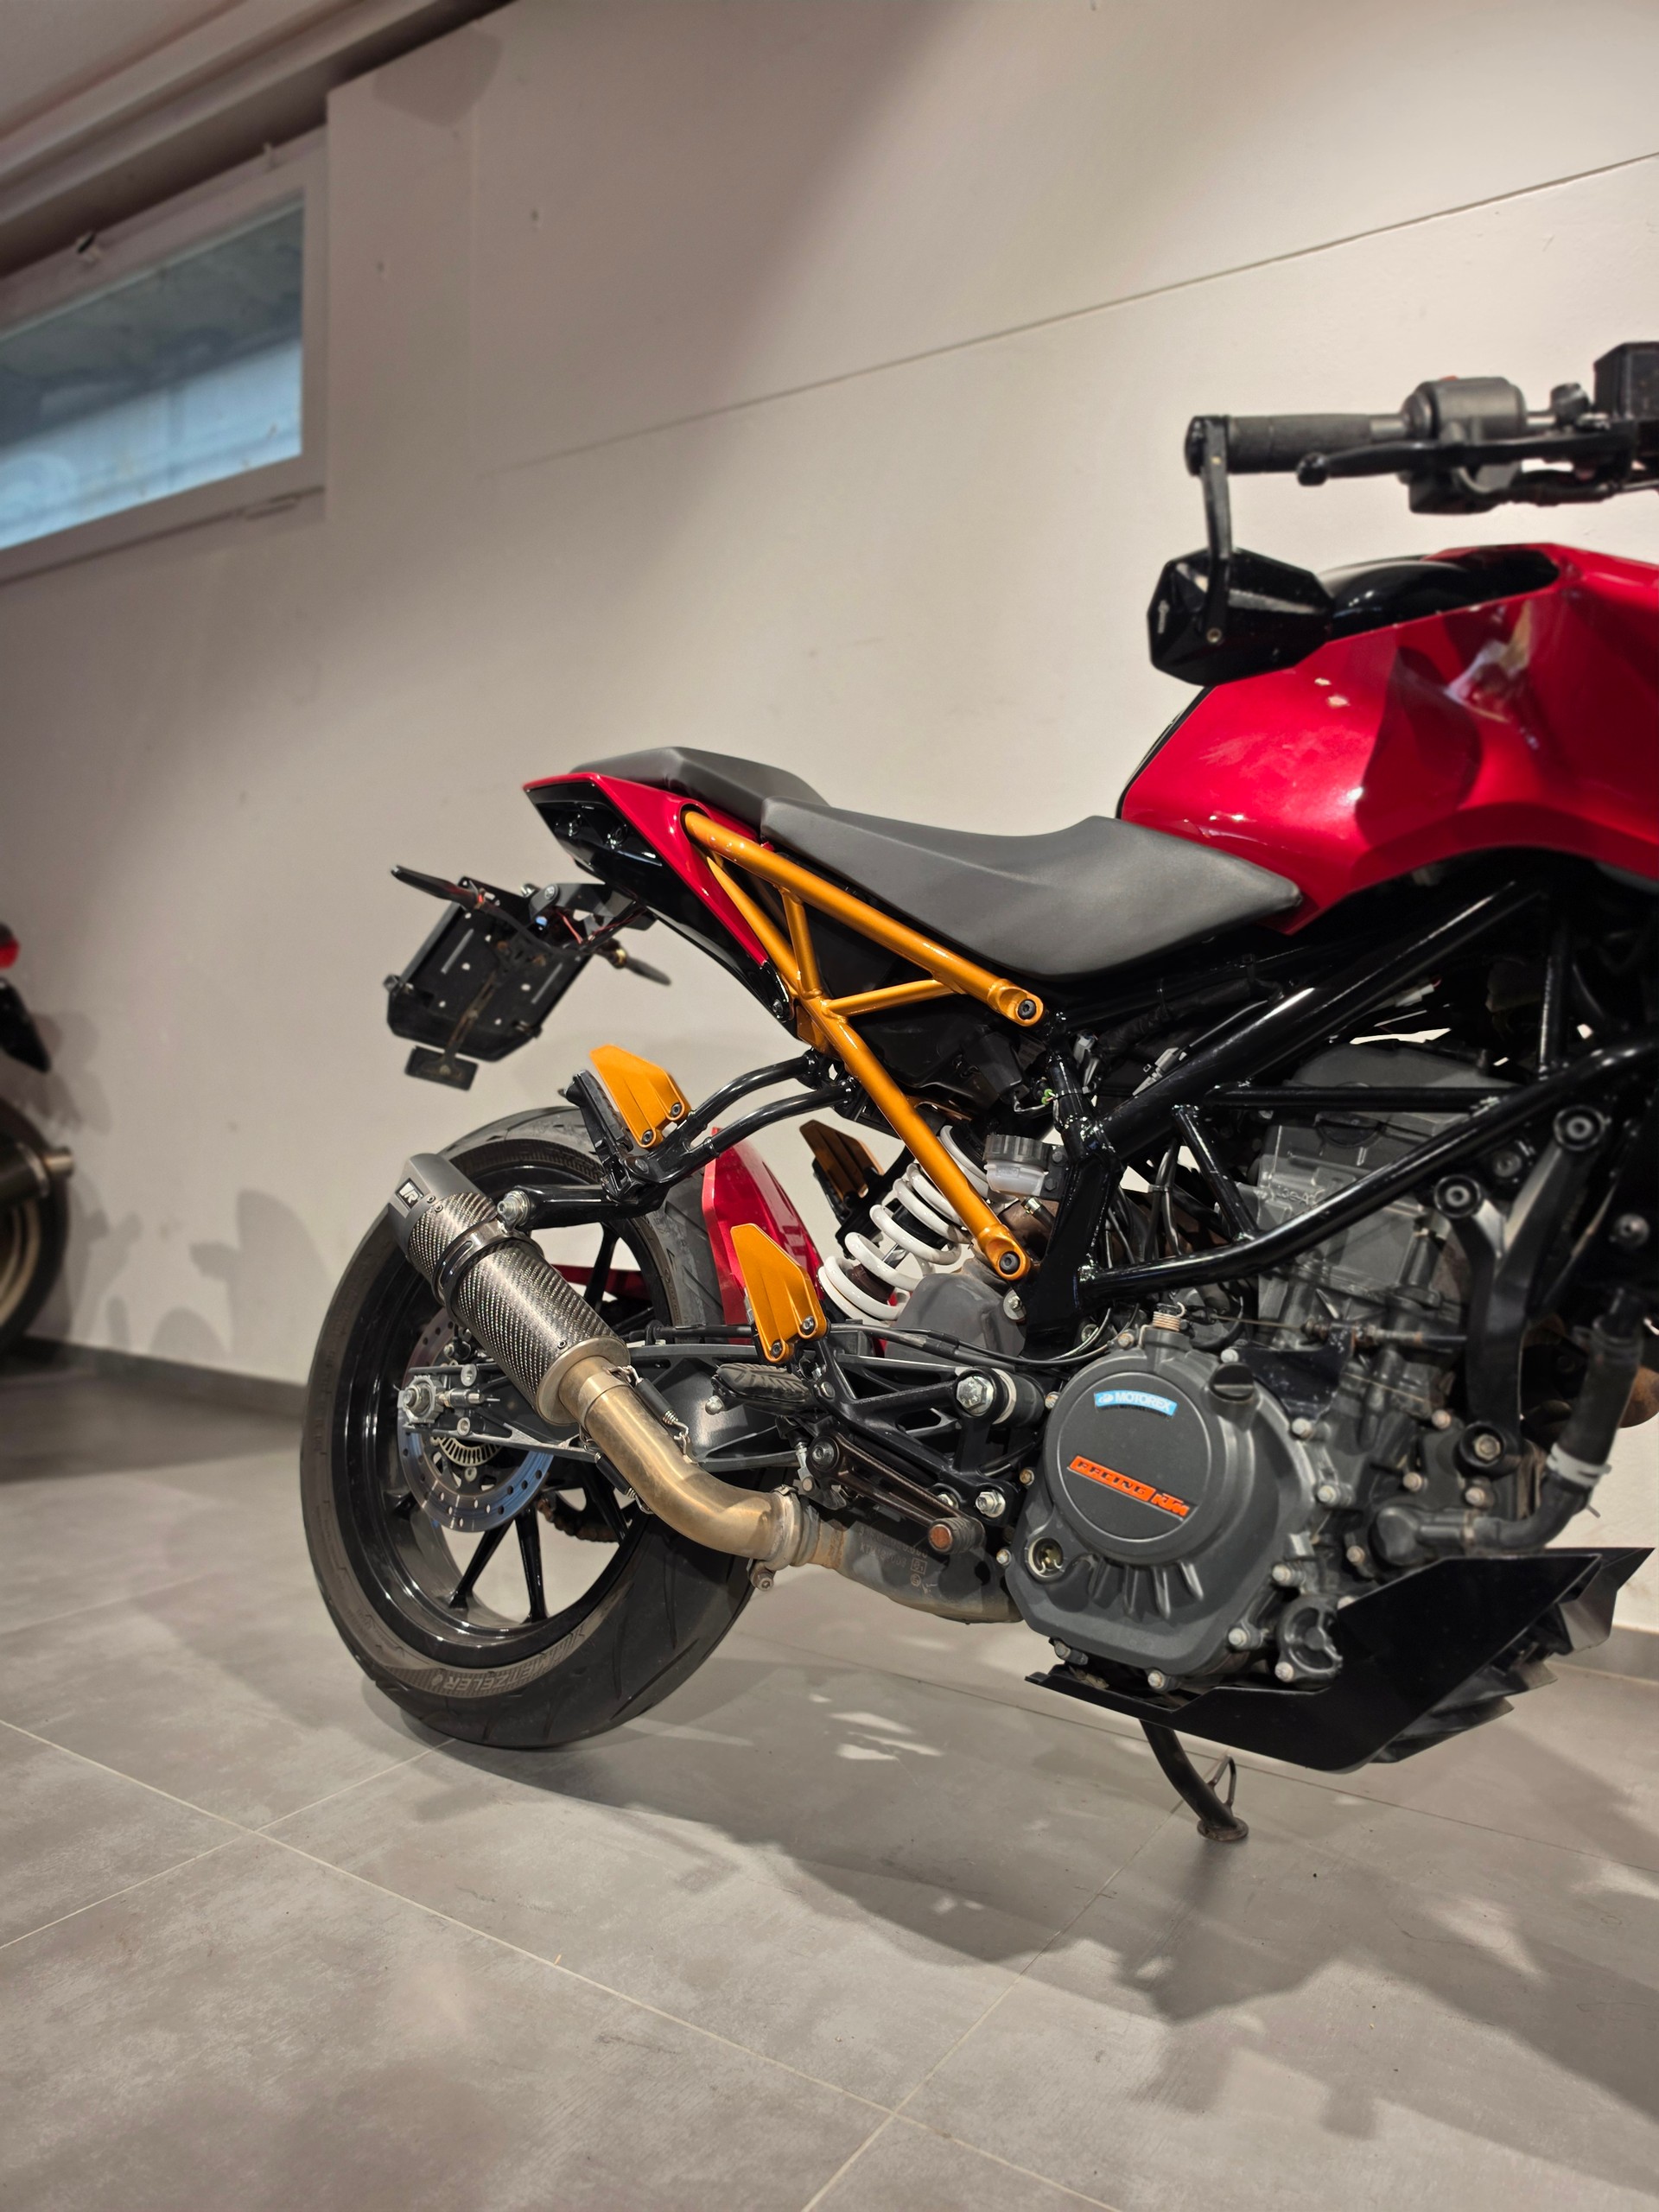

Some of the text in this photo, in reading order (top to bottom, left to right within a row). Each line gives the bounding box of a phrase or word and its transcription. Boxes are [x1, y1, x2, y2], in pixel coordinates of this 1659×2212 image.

[1115, 1391, 1171, 1412] MOTOREX
[1150, 1492, 1190, 1516] KTM
[443, 1655, 549, 1691] METZELER
